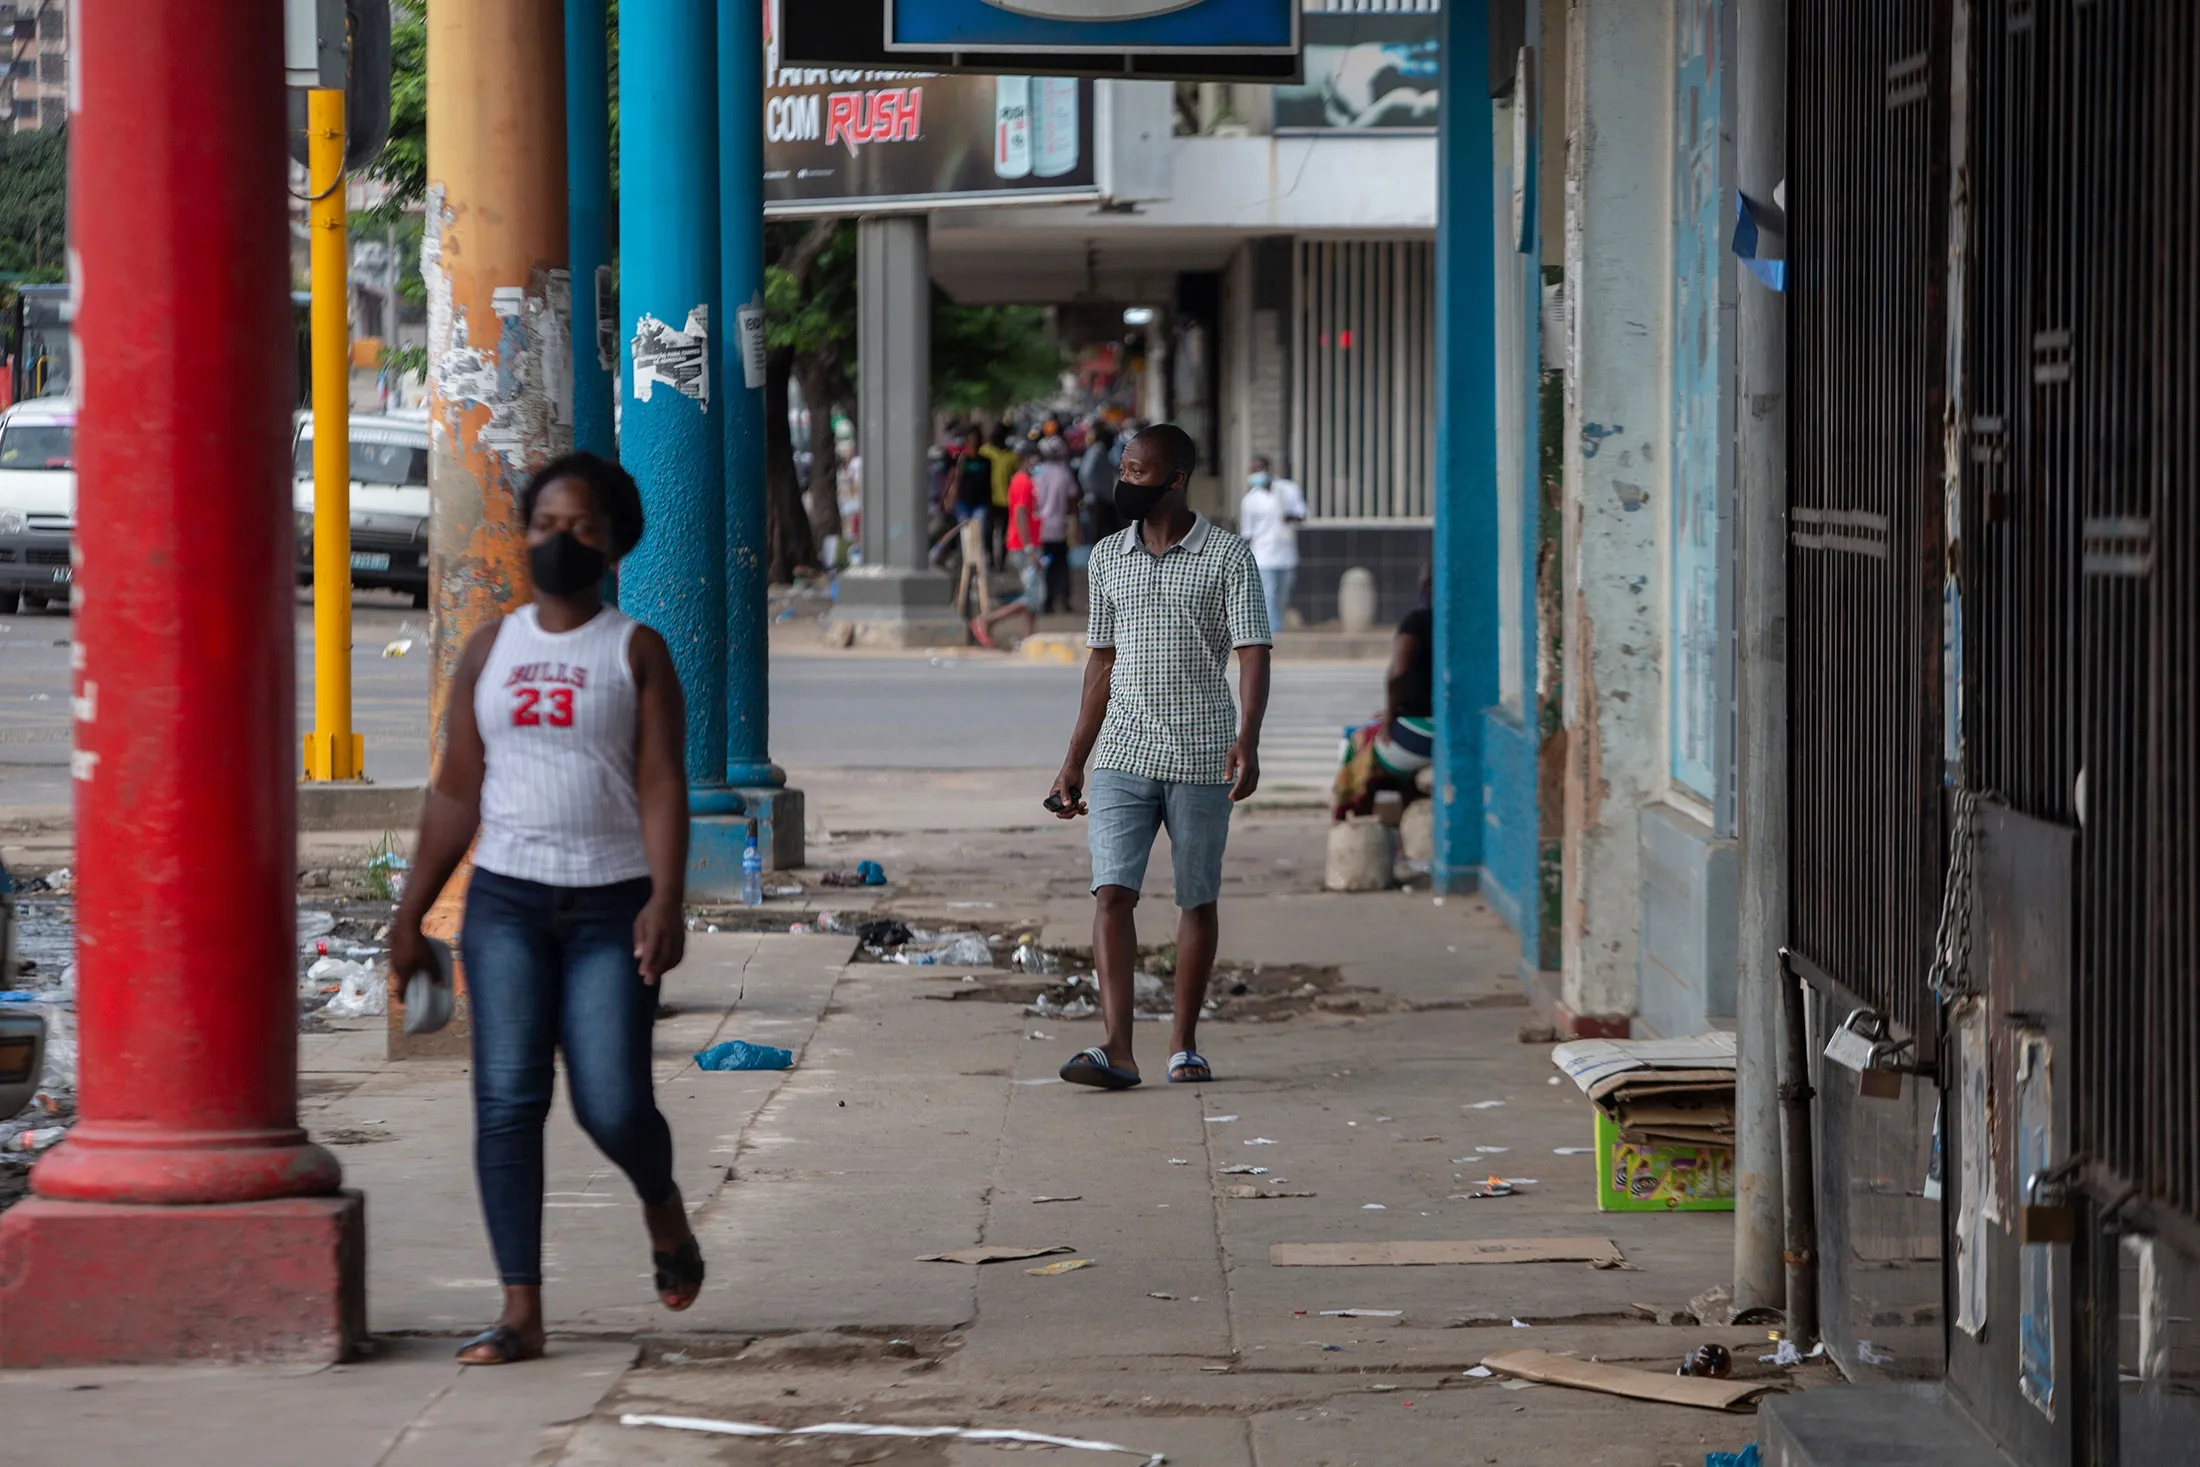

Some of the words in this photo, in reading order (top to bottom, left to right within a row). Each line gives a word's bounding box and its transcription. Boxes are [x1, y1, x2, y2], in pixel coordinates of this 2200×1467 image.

[766, 94, 820, 143] COM
[825, 87, 923, 159] RUSH
[505, 662, 587, 688] BULLS
[511, 688, 574, 727] 23
